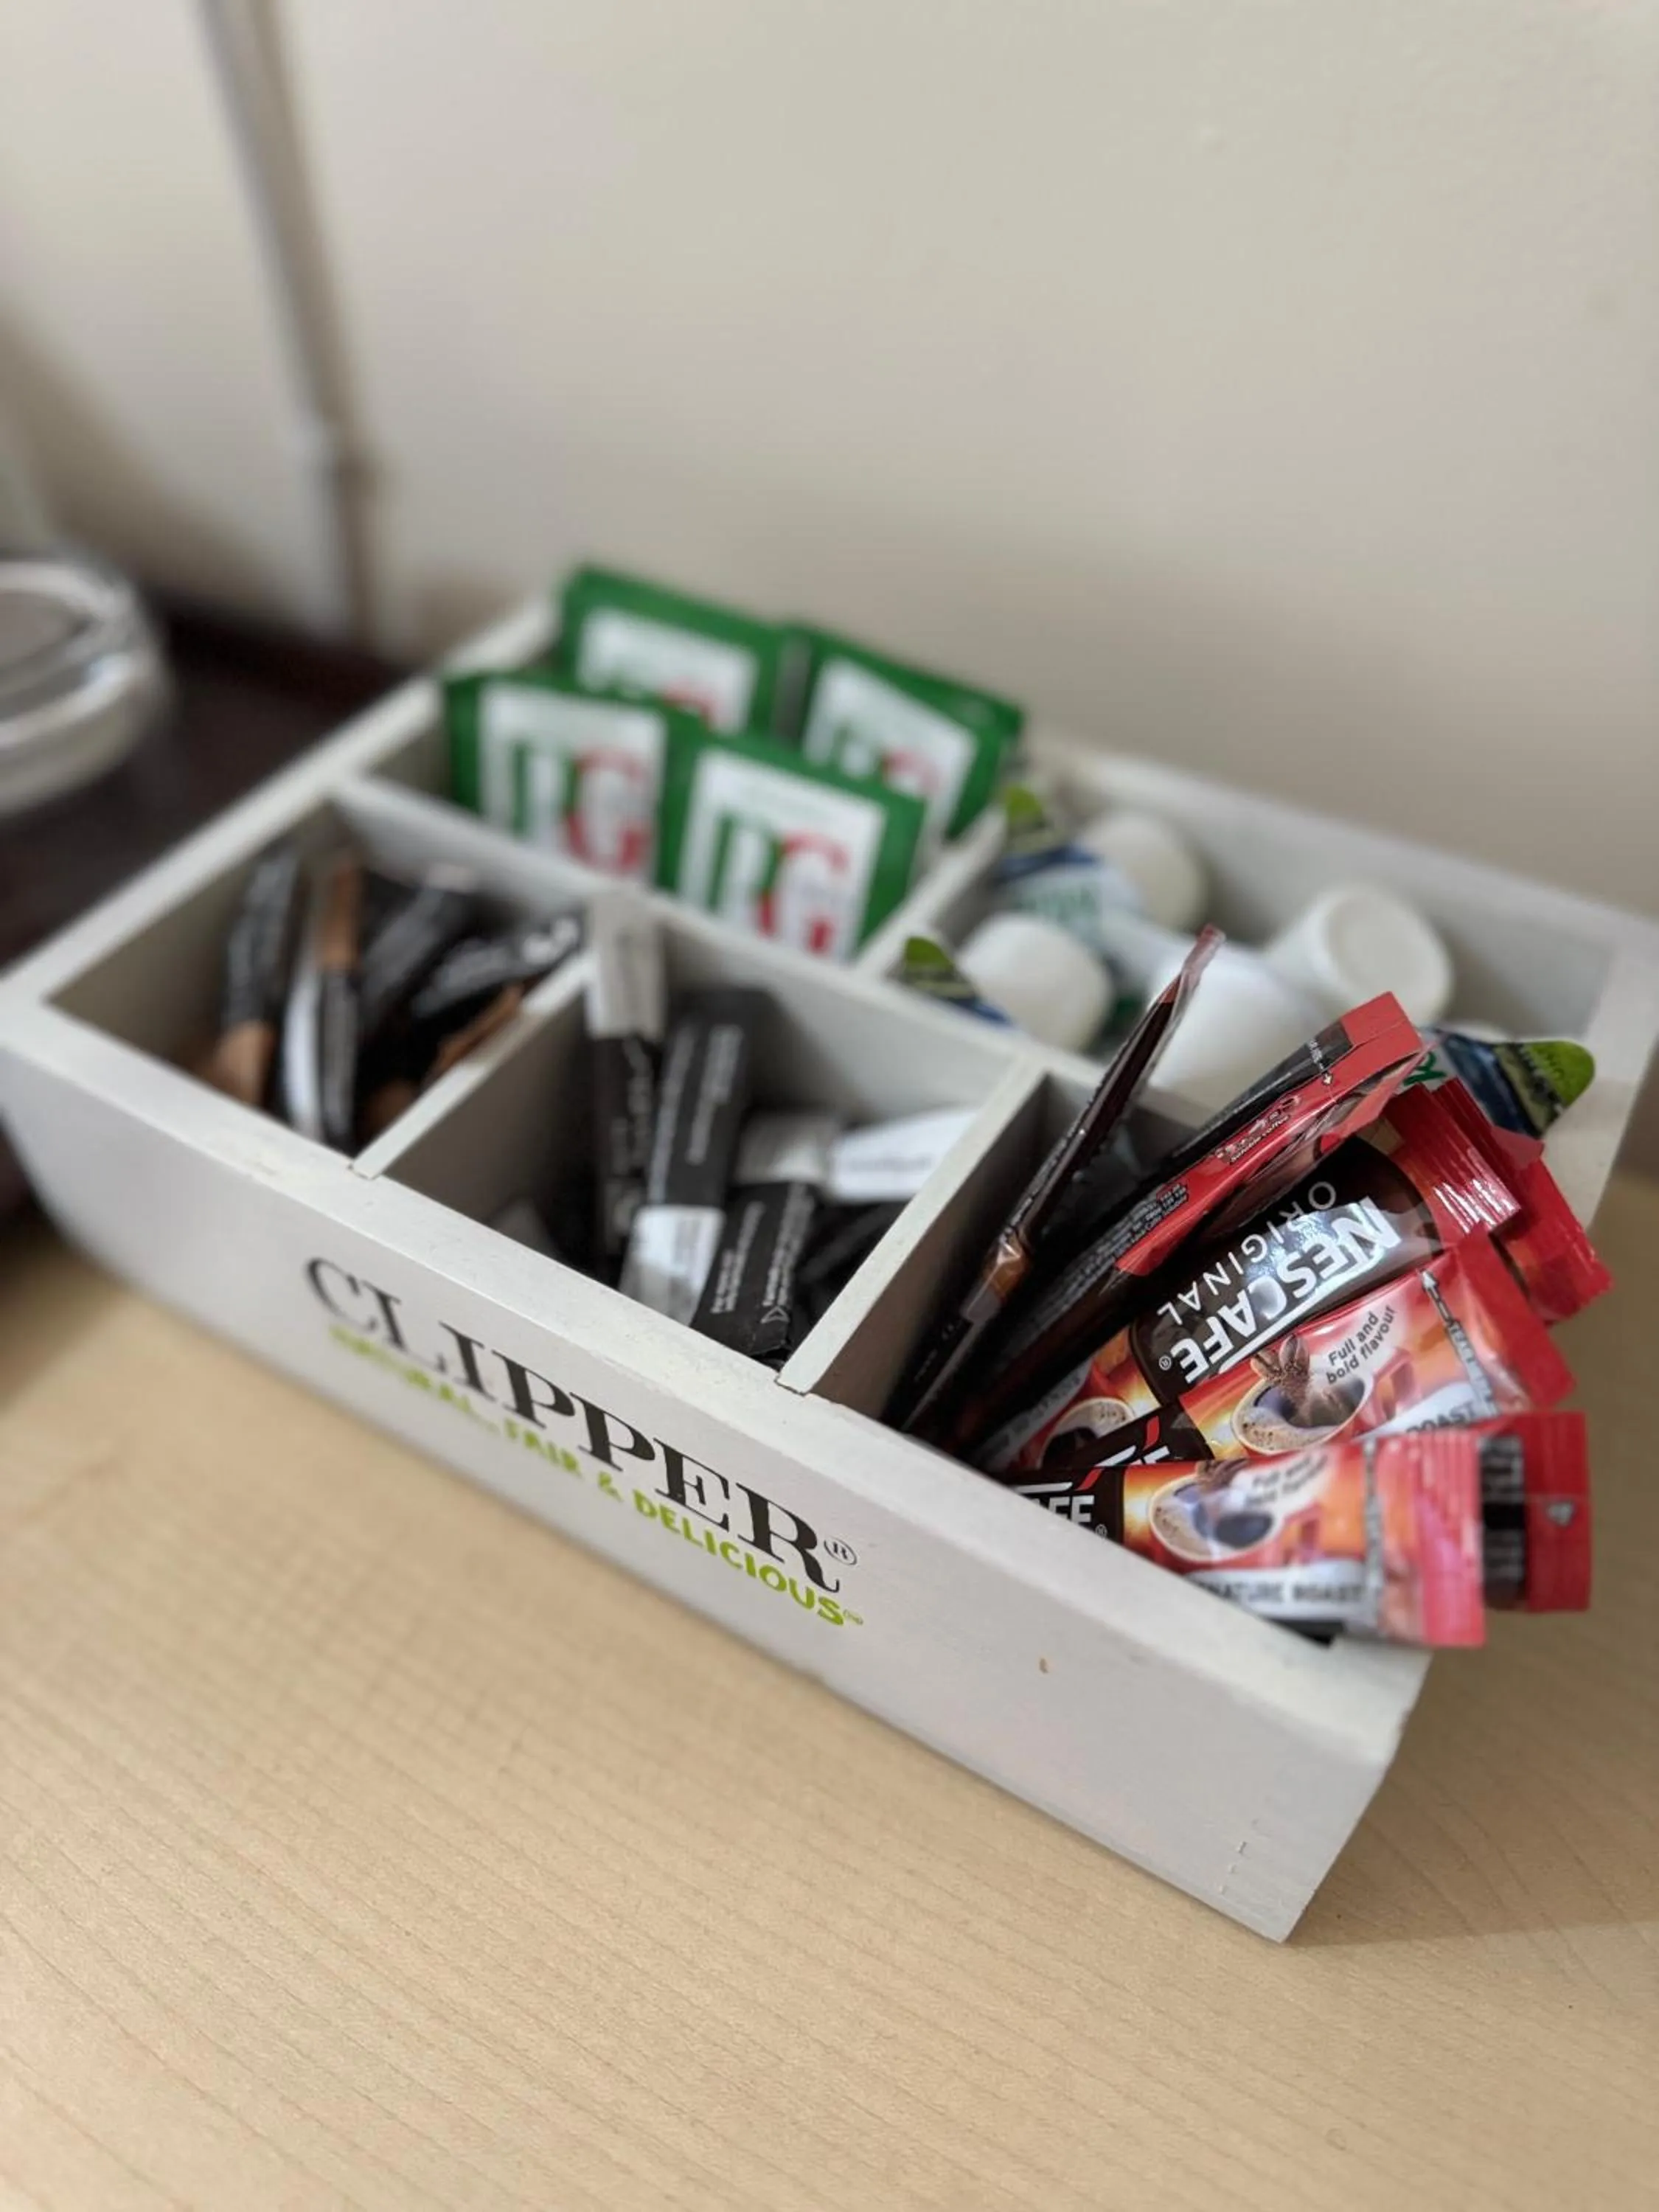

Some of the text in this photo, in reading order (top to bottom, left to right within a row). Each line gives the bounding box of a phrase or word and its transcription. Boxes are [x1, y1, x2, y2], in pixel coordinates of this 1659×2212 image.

[1157, 1181, 1336, 1326] ORIGINAL
[1326, 1305, 1397, 1385] bold flavour
[1328, 1310, 1379, 1366] Full and
